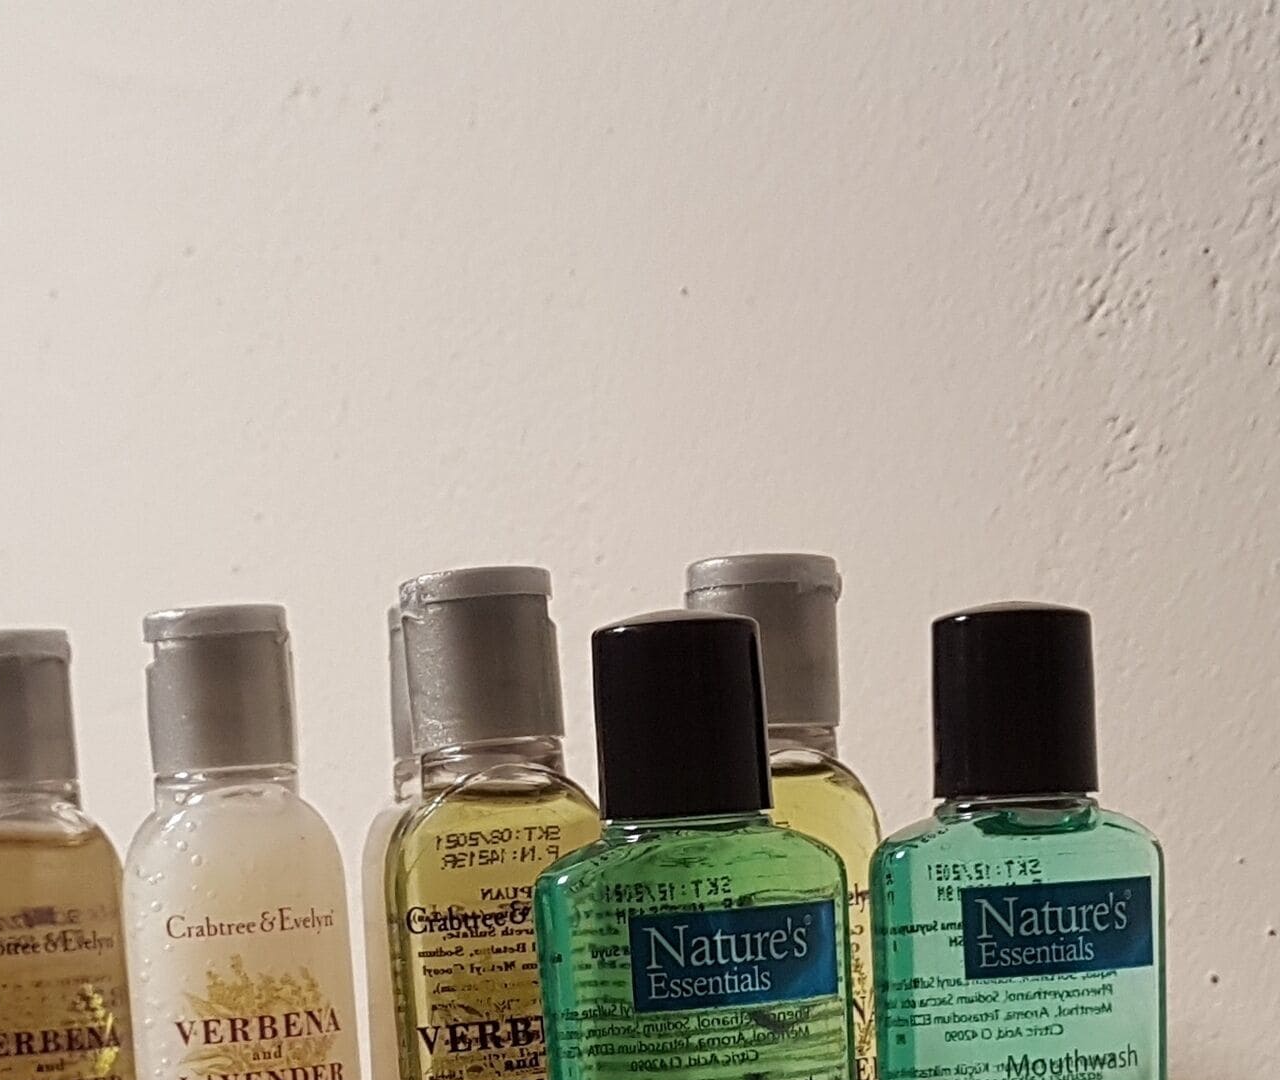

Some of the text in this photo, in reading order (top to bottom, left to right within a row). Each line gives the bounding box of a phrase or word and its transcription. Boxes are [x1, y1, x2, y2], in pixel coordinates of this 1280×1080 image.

[166, 907, 333, 940] Crabtree & Evelyn
[405, 906, 506, 935] Crabtree
[977, 890, 1128, 940] Nature's
[642, 917, 808, 970] Nature's
[979, 934, 1096, 968] Essentials
[647, 965, 771, 1000] Essentials
[175, 1006, 342, 1047] VERBENA
[36, 1058, 65, 1073] and
[252, 1044, 283, 1061] and
[504, 1053, 540, 1072] and
[1006, 1044, 1139, 1079] Mouthwash
